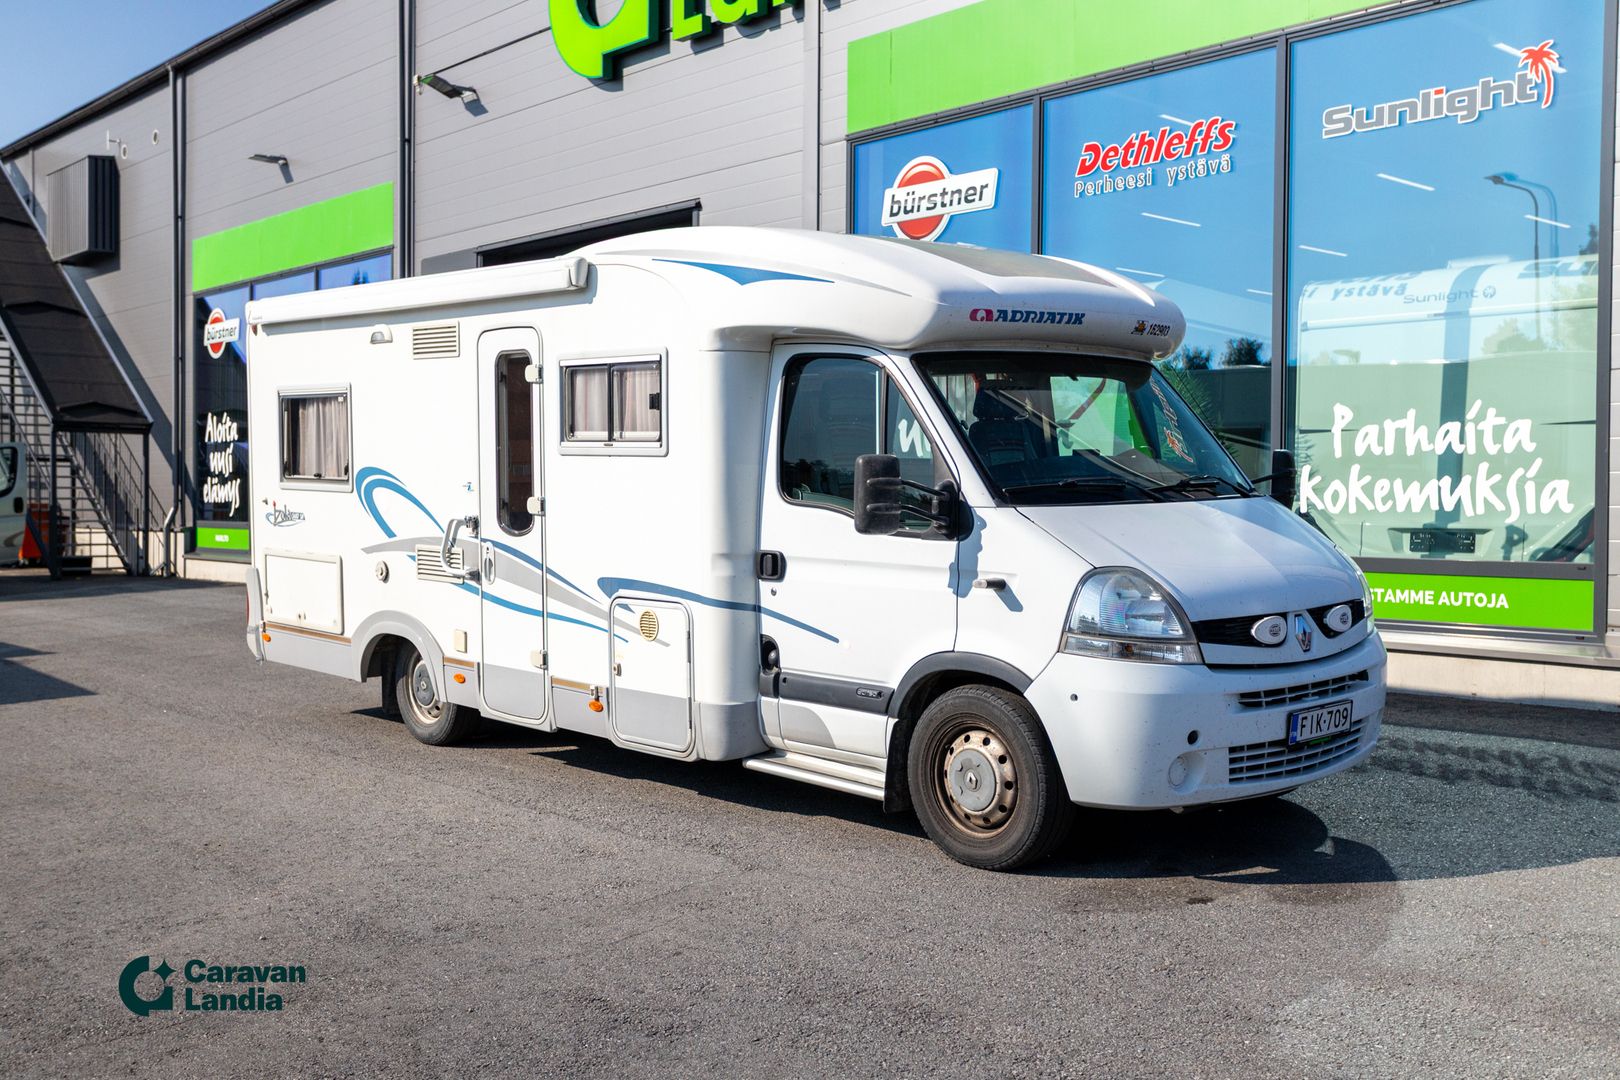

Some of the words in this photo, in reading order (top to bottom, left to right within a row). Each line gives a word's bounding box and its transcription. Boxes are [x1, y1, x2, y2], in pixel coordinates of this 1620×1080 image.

[1323, 70, 1538, 139] Sunlight
[1075, 116, 1236, 177] Dethleffs
[1074, 167, 1153, 197] Perheesi
[1166, 154, 1231, 186] ystävä
[889, 183, 989, 218] bürstner
[1403, 289, 1478, 304] Sunlight
[995, 309, 1086, 325] ADRIATIK
[205, 412, 238, 442] Aloita
[1331, 399, 1537, 458] Parhaita
[209, 443, 233, 477] uusi
[203, 476, 240, 517] elämys
[1299, 457, 1574, 524] kokemuksia
[1438, 591, 1509, 608] AUTOJA
[1300, 707, 1349, 737] FIK-709
